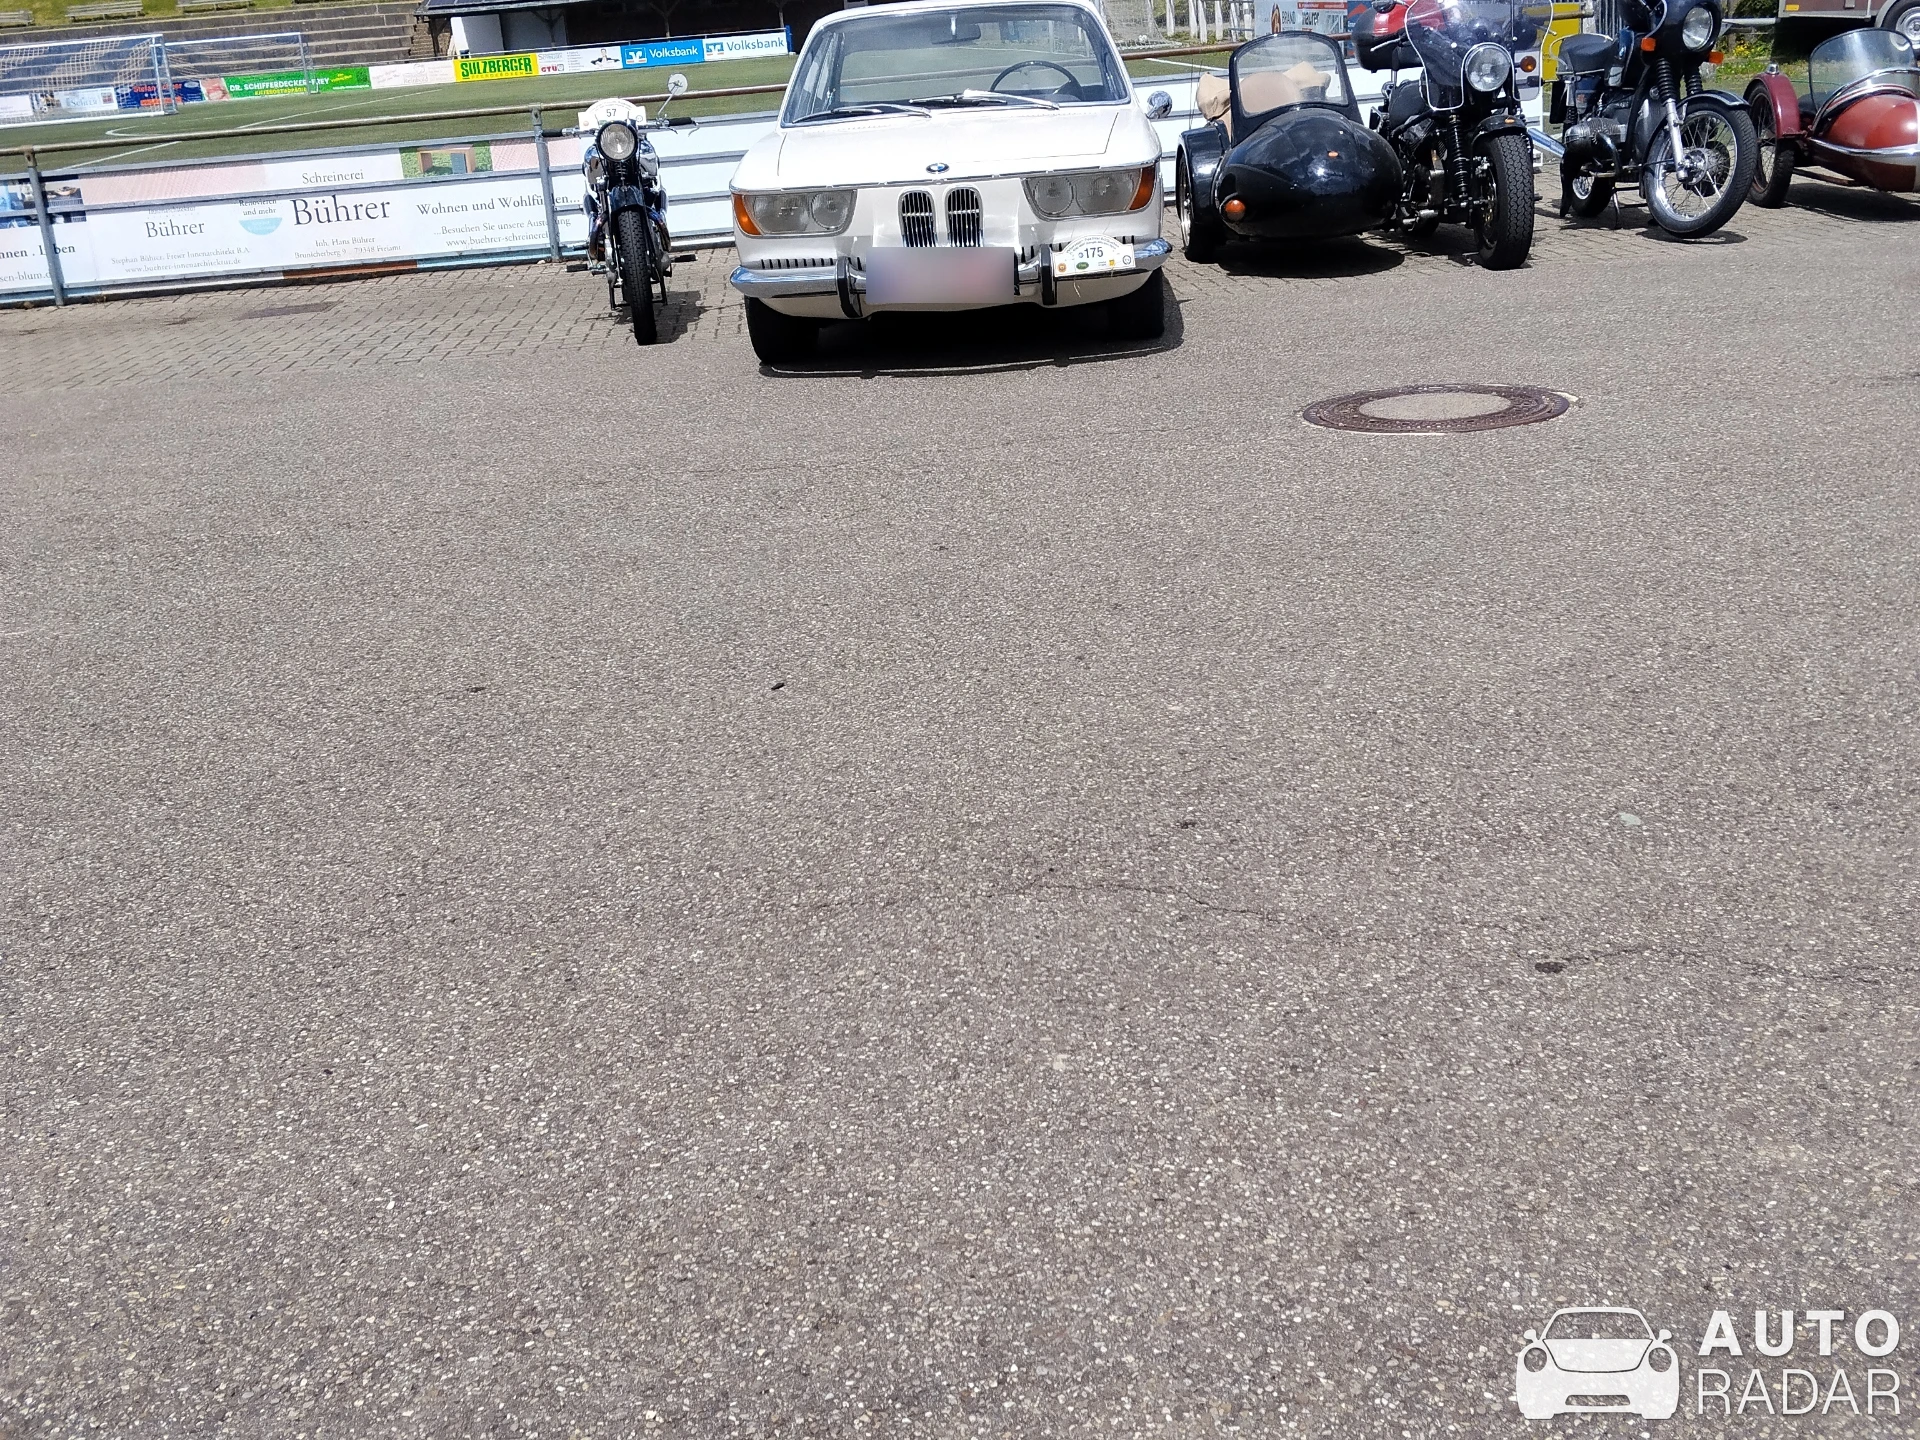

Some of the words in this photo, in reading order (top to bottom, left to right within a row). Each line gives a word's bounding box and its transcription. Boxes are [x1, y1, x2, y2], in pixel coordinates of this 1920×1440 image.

[726, 38, 785, 52] Volksbank
[649, 46, 699, 59] Volksbank
[460, 57, 533, 78] SULZBERGER
[229, 84, 243, 93] DR.
[606, 108, 617, 118] 57
[302, 169, 365, 185] Schreinerei
[243, 207, 257, 217] und
[258, 206, 277, 215] mehr
[290, 194, 391, 226] Bührer
[416, 202, 469, 216] Wohnen
[471, 198, 496, 211] und
[144, 218, 205, 238] Bührer
[483, 222, 496, 232] Sie
[497, 221, 526, 231] unsere
[331, 238, 350, 247] Hans
[1084, 246, 1104, 259] 175
[111, 256, 139, 266] Stephan
